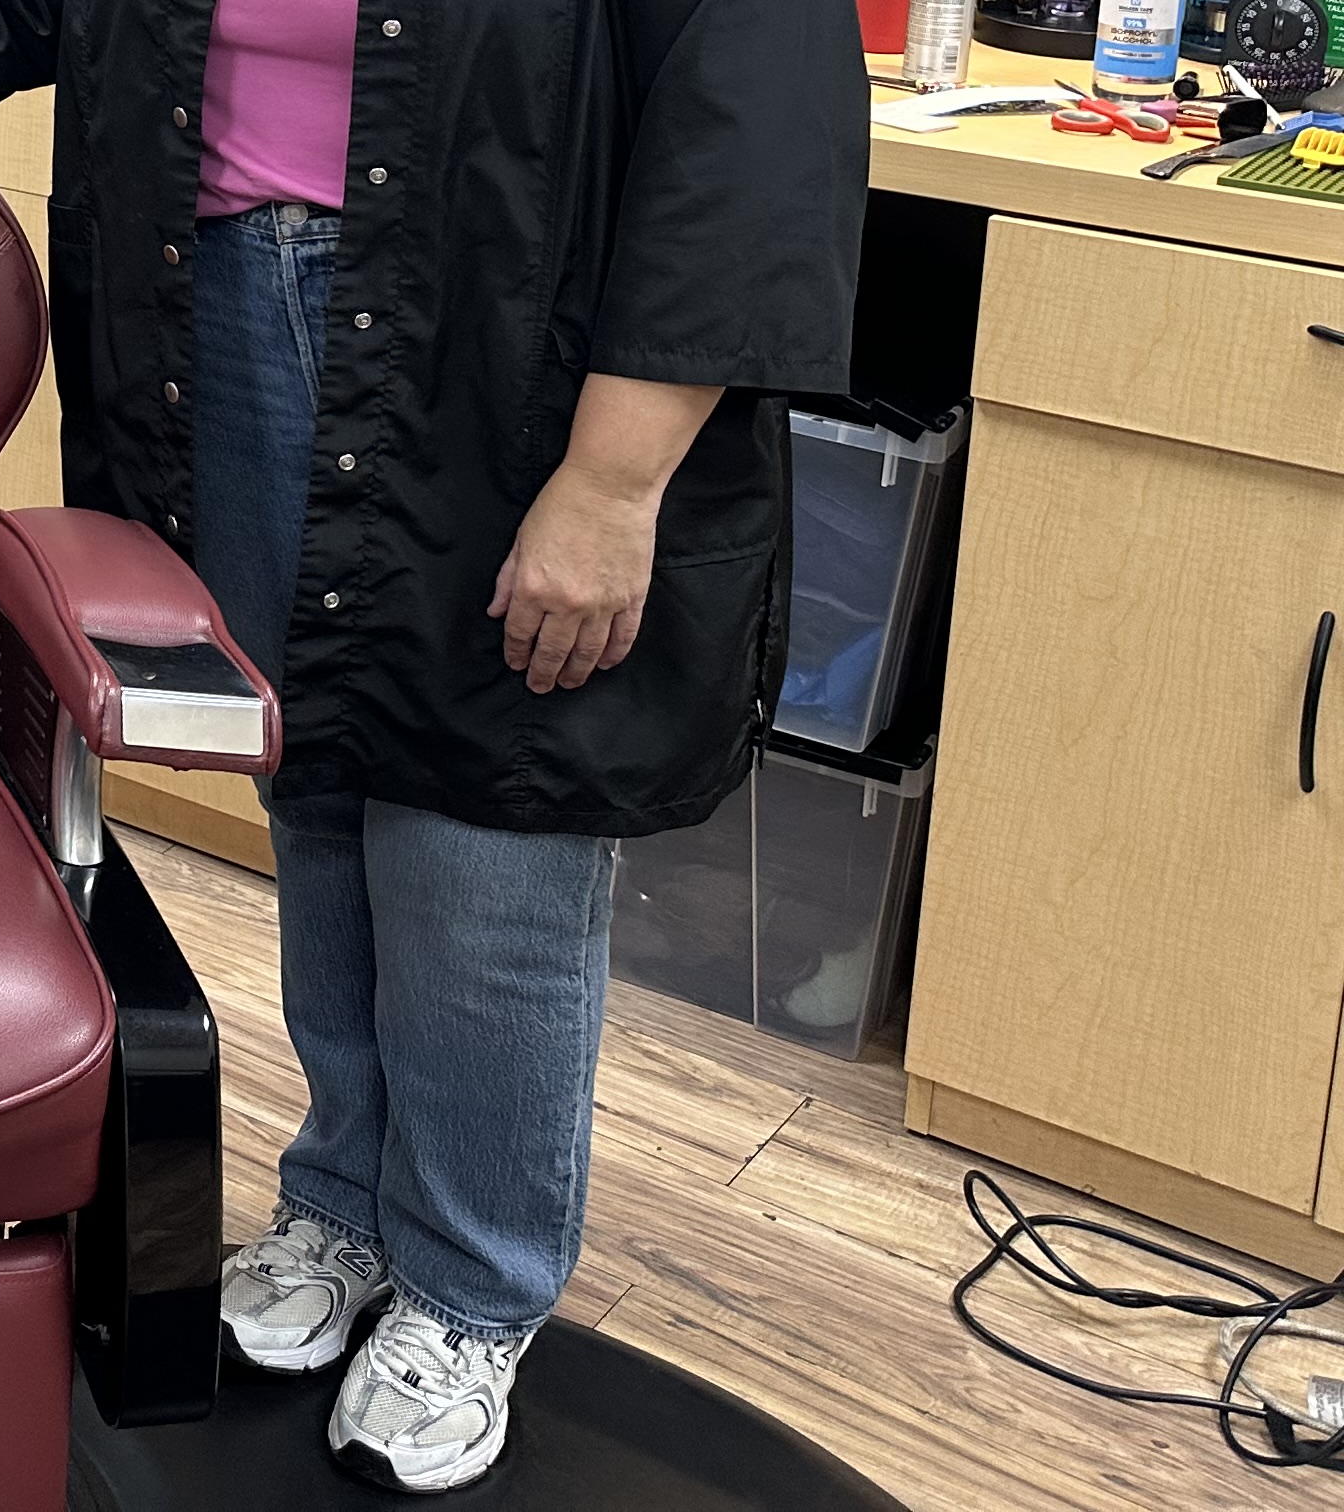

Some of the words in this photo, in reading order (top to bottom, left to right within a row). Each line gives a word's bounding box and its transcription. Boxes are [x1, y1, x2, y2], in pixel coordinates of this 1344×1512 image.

[1126, 19, 1143, 28] 99%
[1241, 22, 1251, 32] 15
[1113, 35, 1155, 44] ALCOHOL
[1270, 52, 1281, 60] 30
